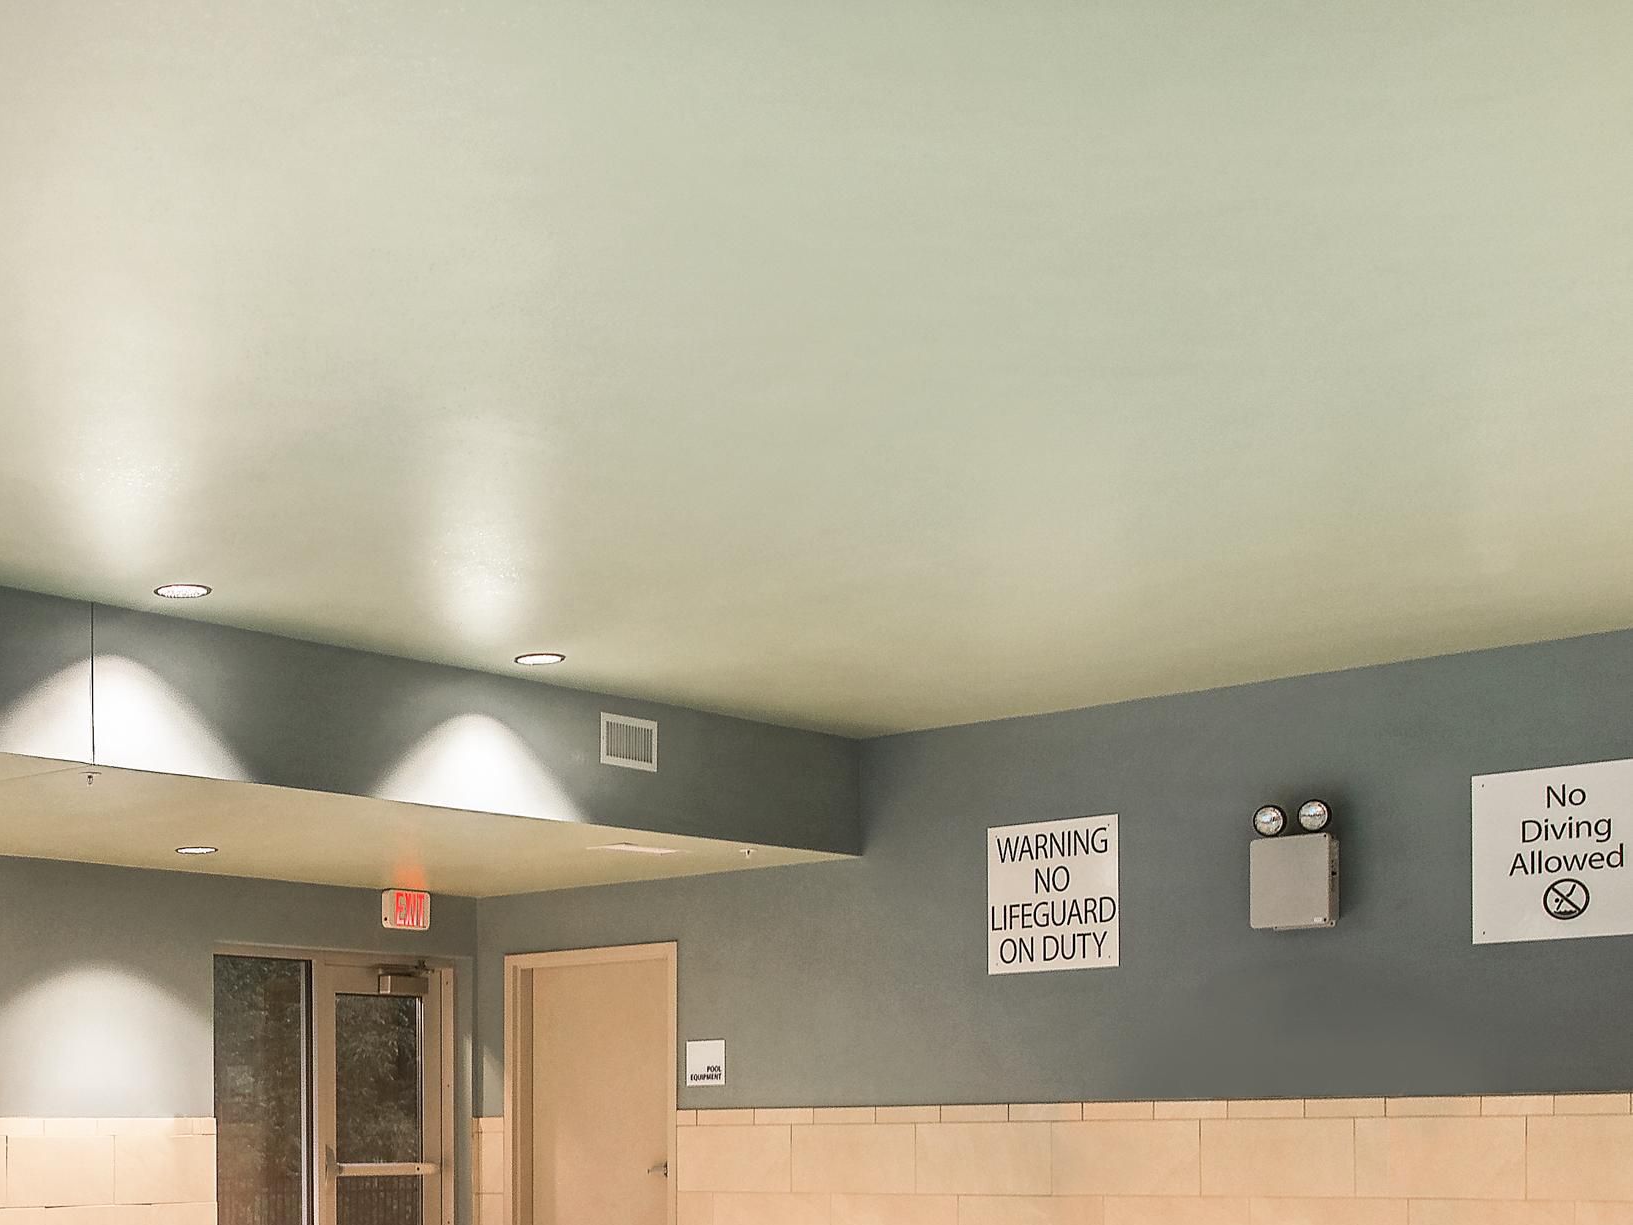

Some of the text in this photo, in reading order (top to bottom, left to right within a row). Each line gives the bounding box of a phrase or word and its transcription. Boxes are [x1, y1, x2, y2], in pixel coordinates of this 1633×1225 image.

[1546, 783, 1587, 809] No
[996, 826, 1109, 864] WARNING
[1521, 815, 1612, 844] Diving
[1508, 842, 1625, 877] Allowed
[1034, 865, 1070, 894] NO
[394, 891, 426, 928] EXIT
[991, 896, 1117, 932] LIFEGUARD
[999, 930, 1108, 965] ON DUTY
[690, 1072, 722, 1082] EQUIPMENT
[706, 1065, 722, 1073] POOL
